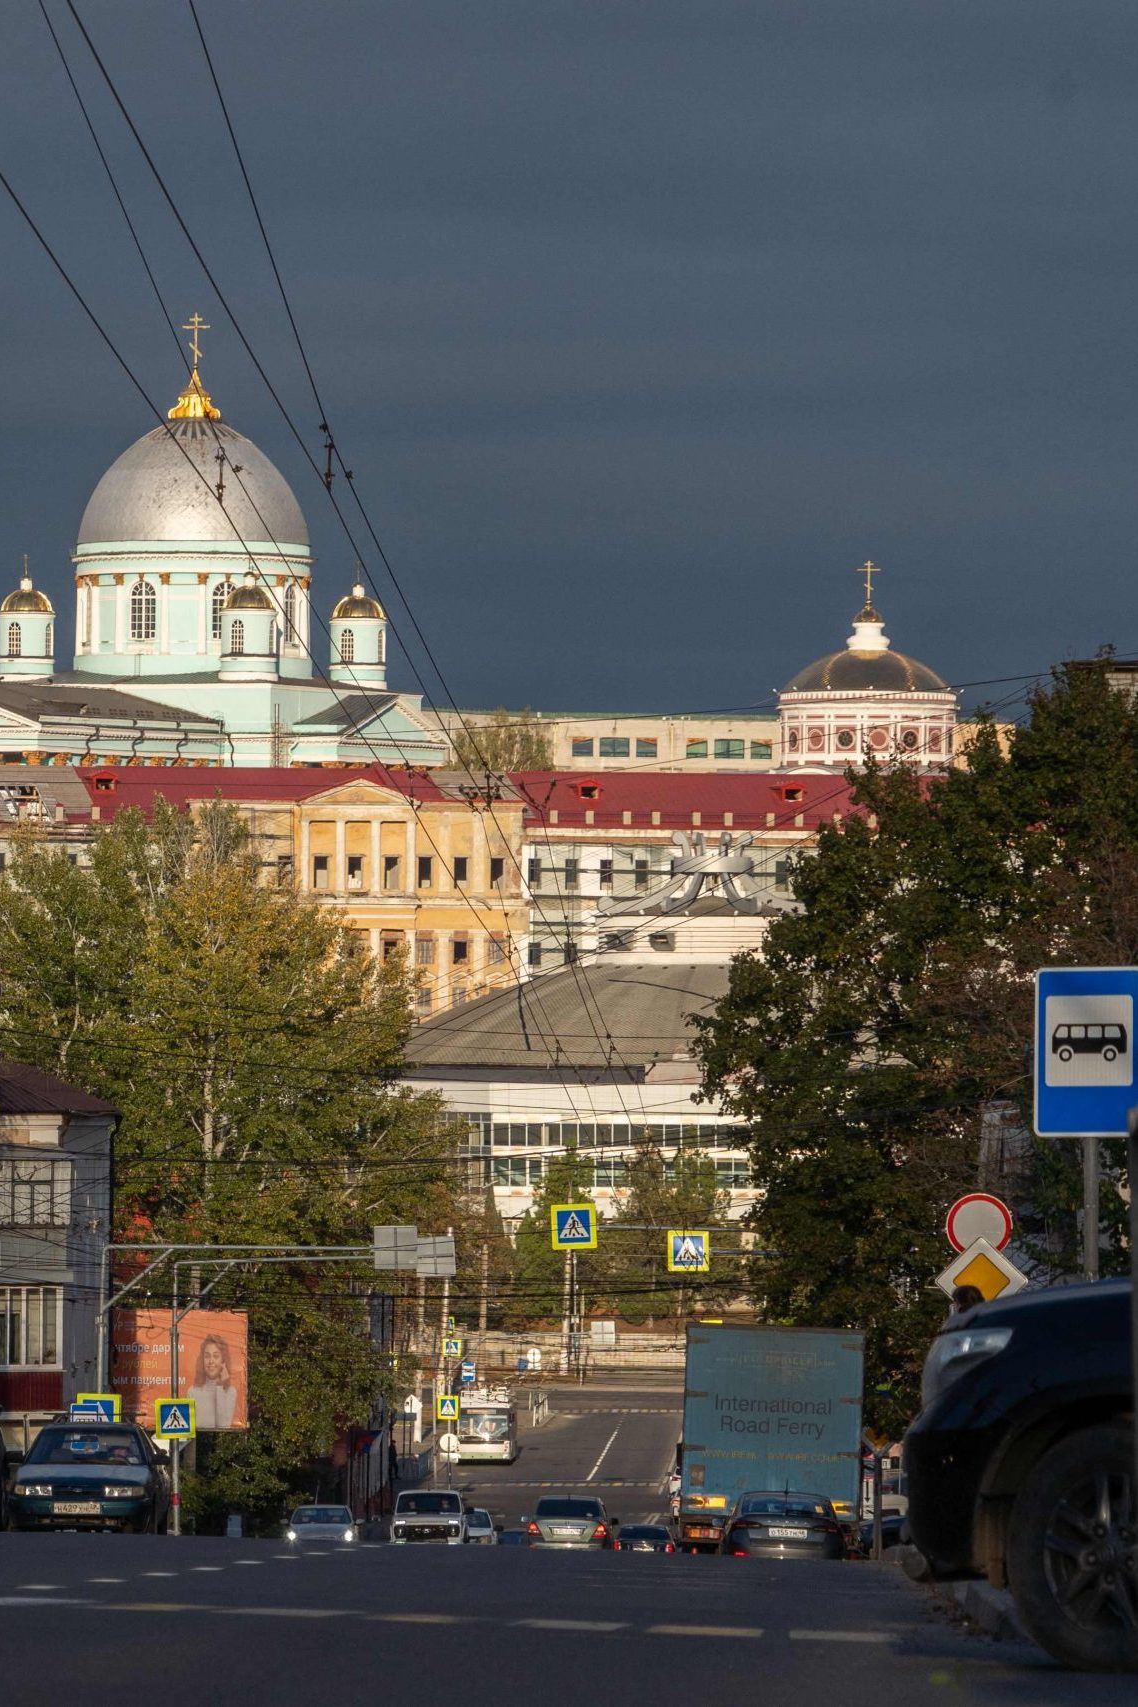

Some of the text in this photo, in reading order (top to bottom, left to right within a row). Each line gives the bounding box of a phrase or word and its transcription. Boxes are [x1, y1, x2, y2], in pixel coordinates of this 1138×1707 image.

[151, 1344, 184, 1355] дарм
[130, 1376, 186, 1386] пациентм
[715, 1393, 832, 1416] International
[720, 1415, 825, 1440] Road Ferry
